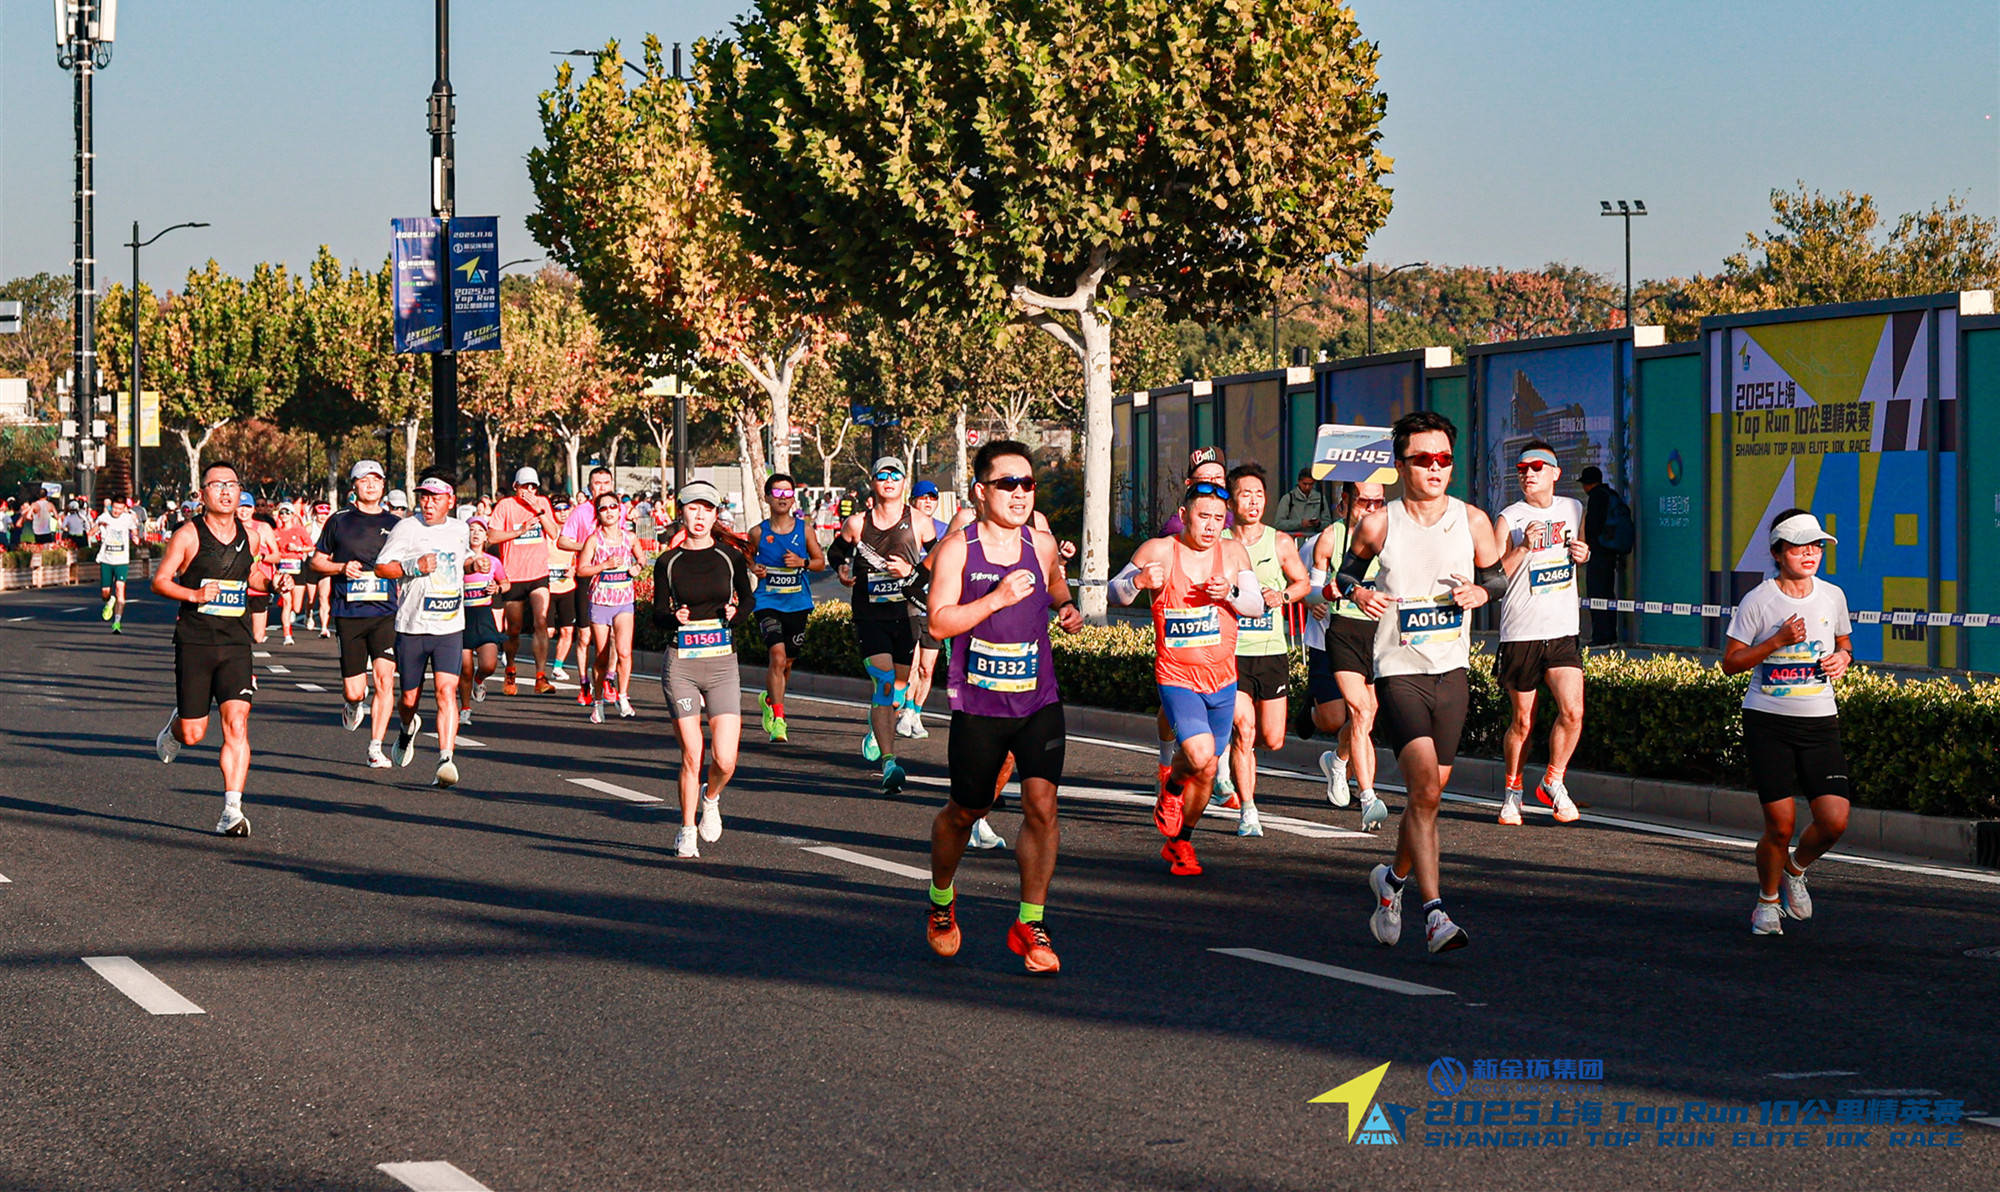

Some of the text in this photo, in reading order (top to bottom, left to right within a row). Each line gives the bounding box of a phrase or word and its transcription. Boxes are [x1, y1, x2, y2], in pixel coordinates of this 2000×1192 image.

[1736, 380, 1795, 410] 2025上海
[1736, 401, 1871, 442] Top Run 10公里精英赛
[1325, 447, 1391, 464] 00:45
[1736, 439, 1871, 457] SHANGHAI TOP RUN ELITE 10K RACE
[769, 576, 797, 585] A2093
[1537, 568, 1570, 583] A2466
[1170, 620, 1211, 634] A1978
[1407, 611, 1456, 628] A0161
[684, 632, 722, 646] B1561
[977, 657, 1026, 675] B1332
